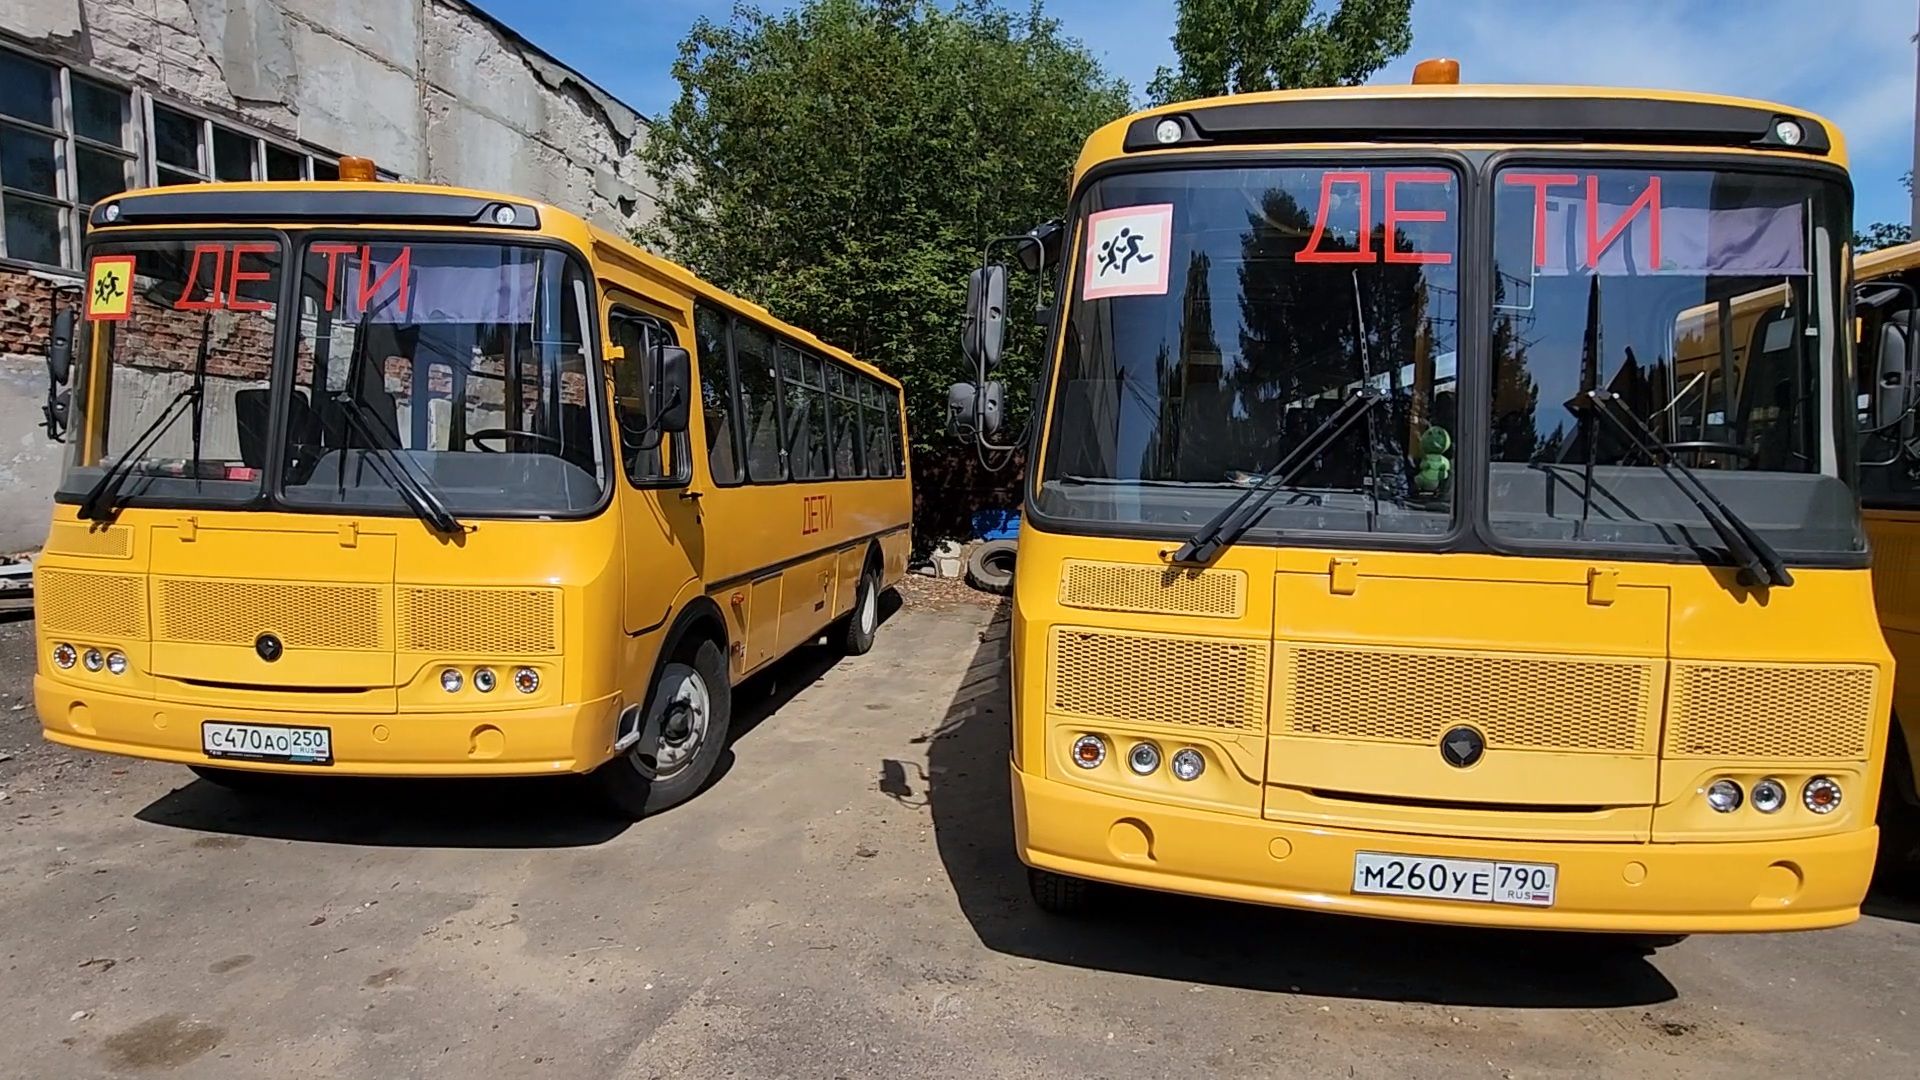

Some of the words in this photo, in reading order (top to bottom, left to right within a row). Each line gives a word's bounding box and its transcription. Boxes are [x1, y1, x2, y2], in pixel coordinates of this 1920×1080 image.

[802, 494, 834, 535] ДЕТИ
[211, 728, 289, 751] С470АО
[292, 731, 323, 747] 250
[1364, 861, 1489, 895] М260УЕ
[1498, 866, 1546, 890] 790
[1507, 889, 1531, 900] RUS
